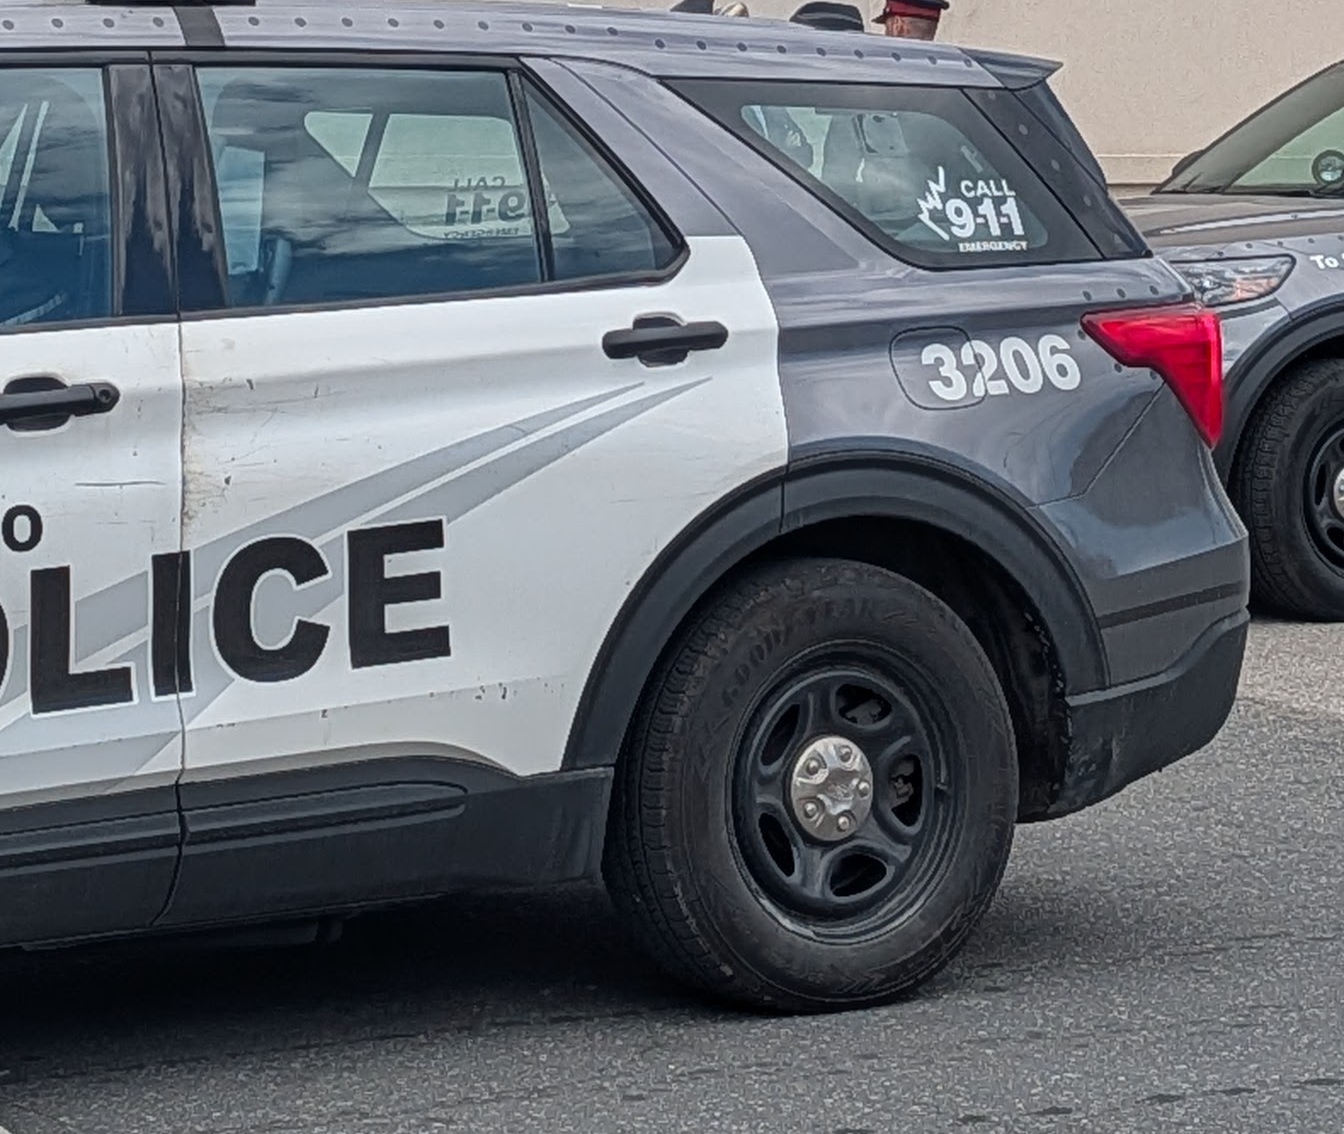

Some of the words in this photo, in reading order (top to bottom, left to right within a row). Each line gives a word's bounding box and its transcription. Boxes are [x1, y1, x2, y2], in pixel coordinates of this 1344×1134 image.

[960, 178, 1016, 198] CALL
[1309, 254, 1339, 270] To
[920, 334, 1082, 402] 3206
